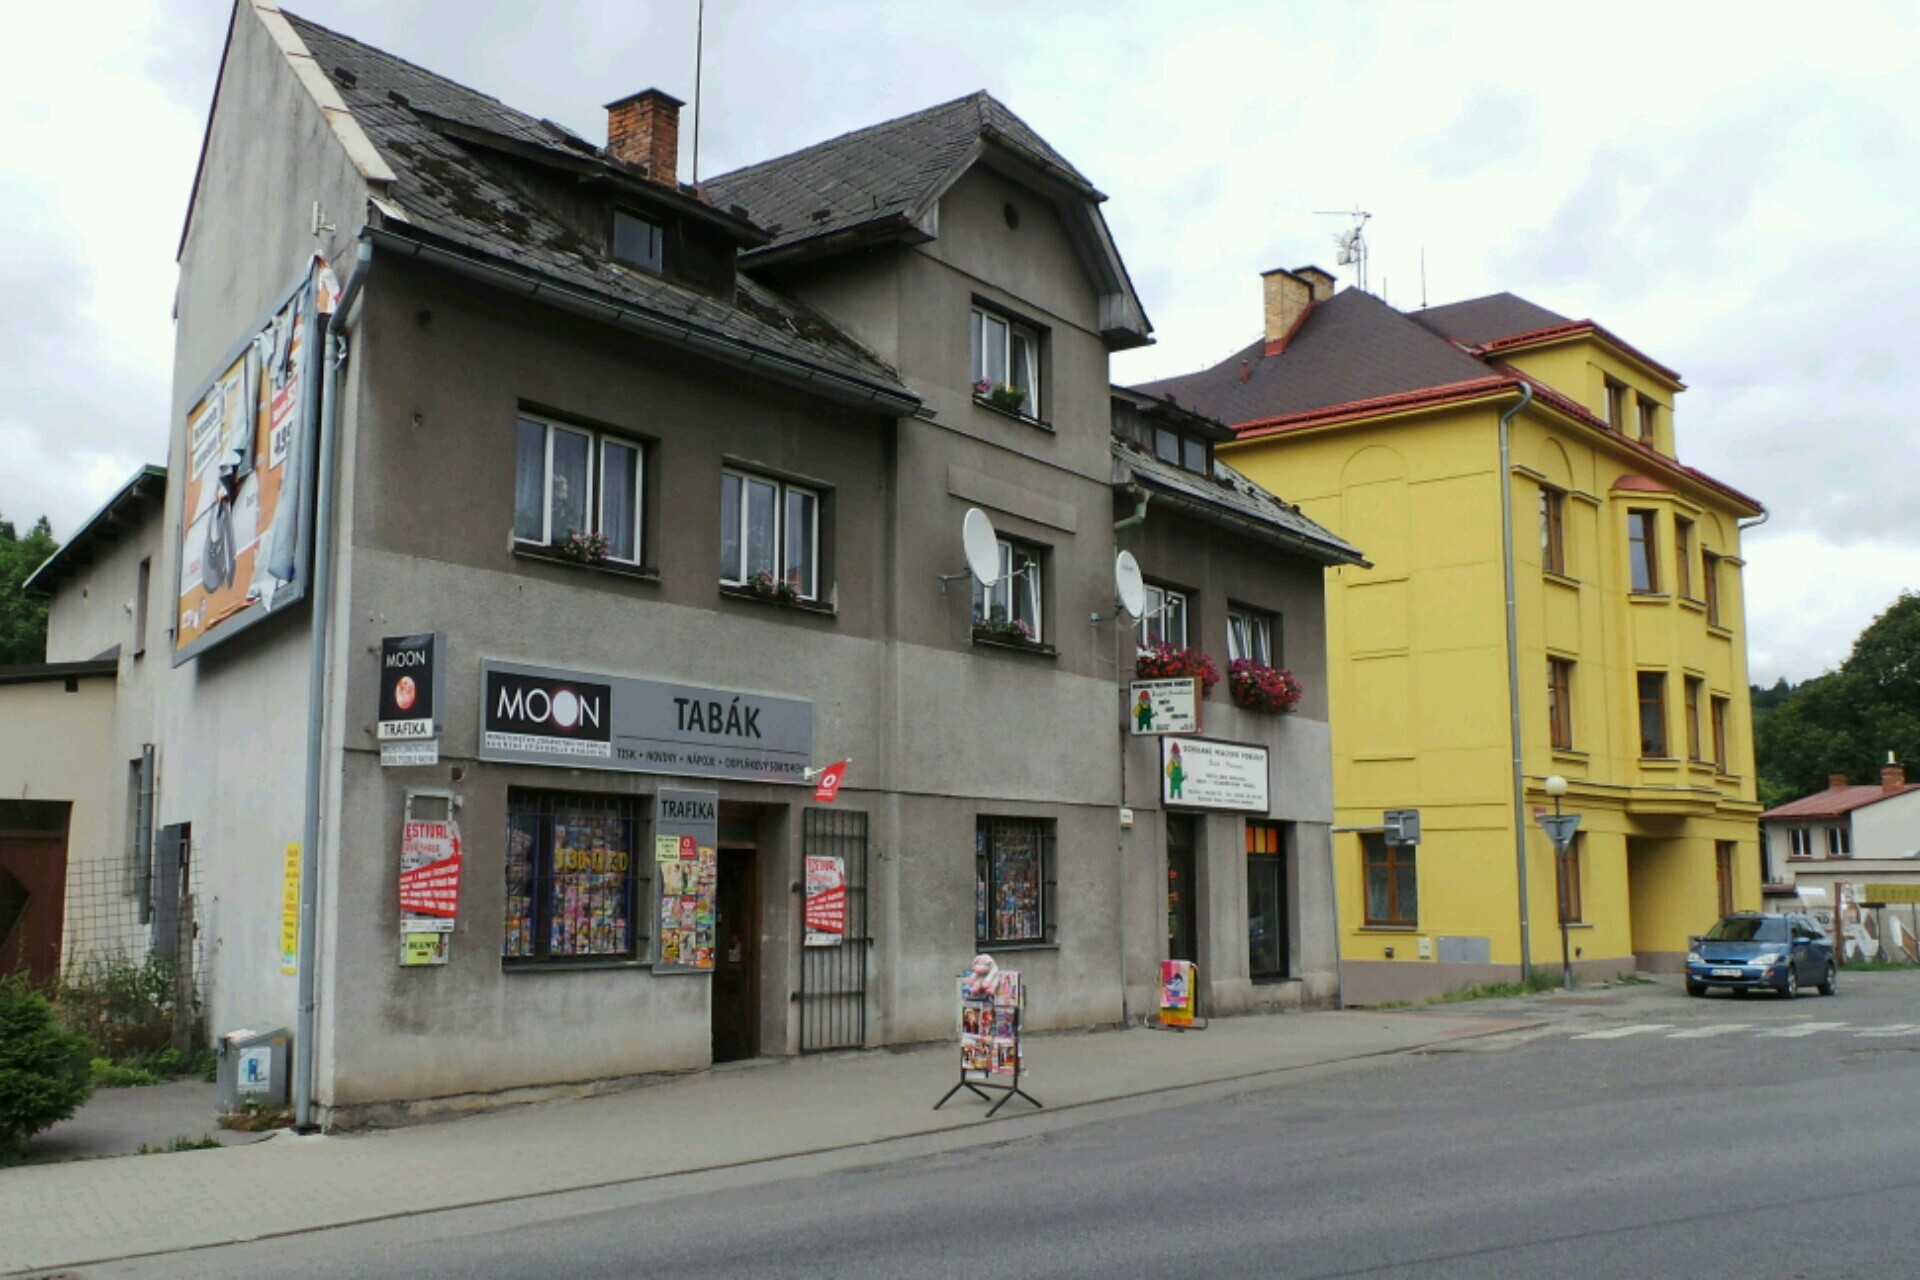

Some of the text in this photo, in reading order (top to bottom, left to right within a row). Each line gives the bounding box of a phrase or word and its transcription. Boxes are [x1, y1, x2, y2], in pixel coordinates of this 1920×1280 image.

[386, 650, 425, 668] MOON
[497, 686, 600, 729] MOON
[673, 696, 762, 739] TABÁK
[383, 722, 427, 737] TRAFIKA
[617, 747, 636, 760] TISK
[646, 751, 677, 763] NOVINY
[661, 800, 715, 819] TRAFIKA
